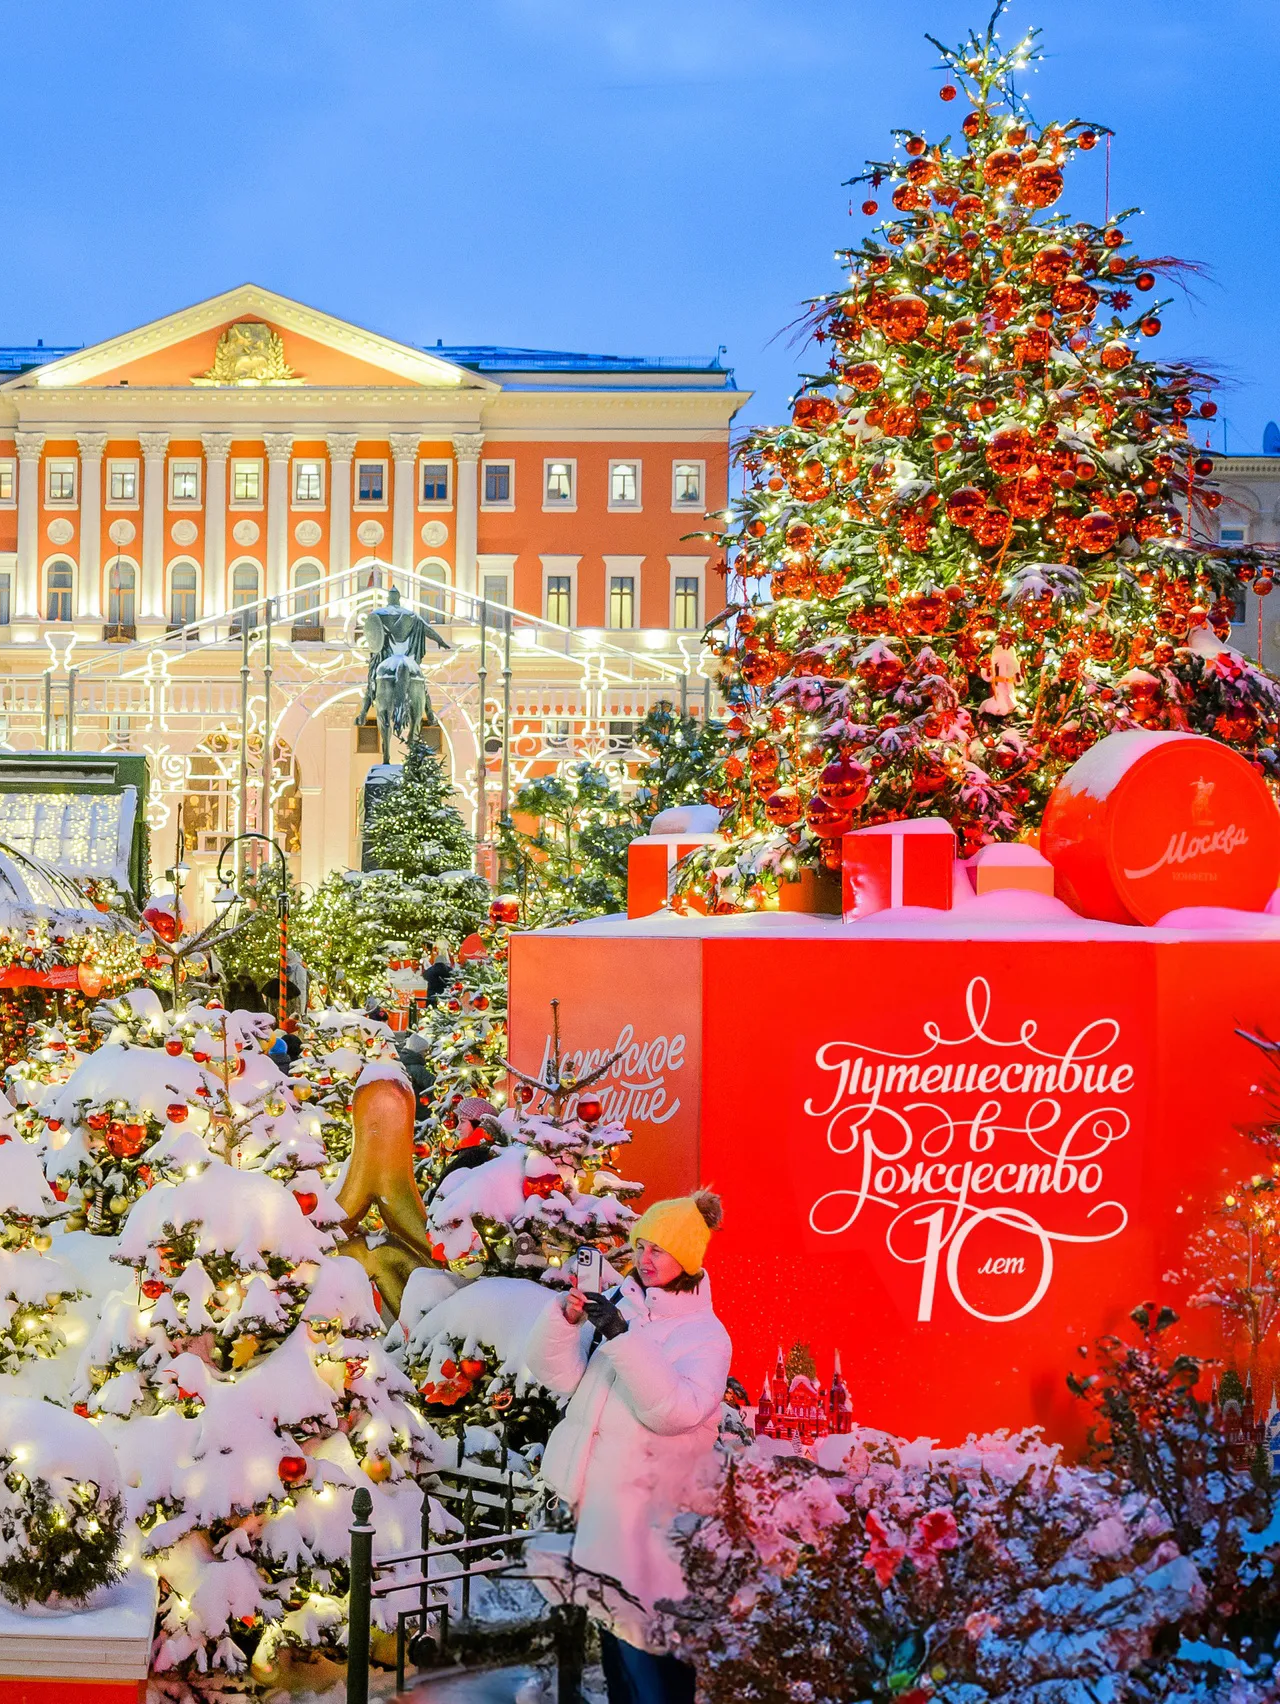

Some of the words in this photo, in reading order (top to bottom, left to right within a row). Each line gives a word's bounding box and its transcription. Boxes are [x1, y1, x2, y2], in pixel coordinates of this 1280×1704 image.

[1126, 823, 1249, 878] Москва
[804, 992, 1136, 1116] Путешествие
[811, 1104, 1126, 1228] Рождество
[913, 1206, 1054, 1323] 10
[977, 1256, 1026, 1275] лет
